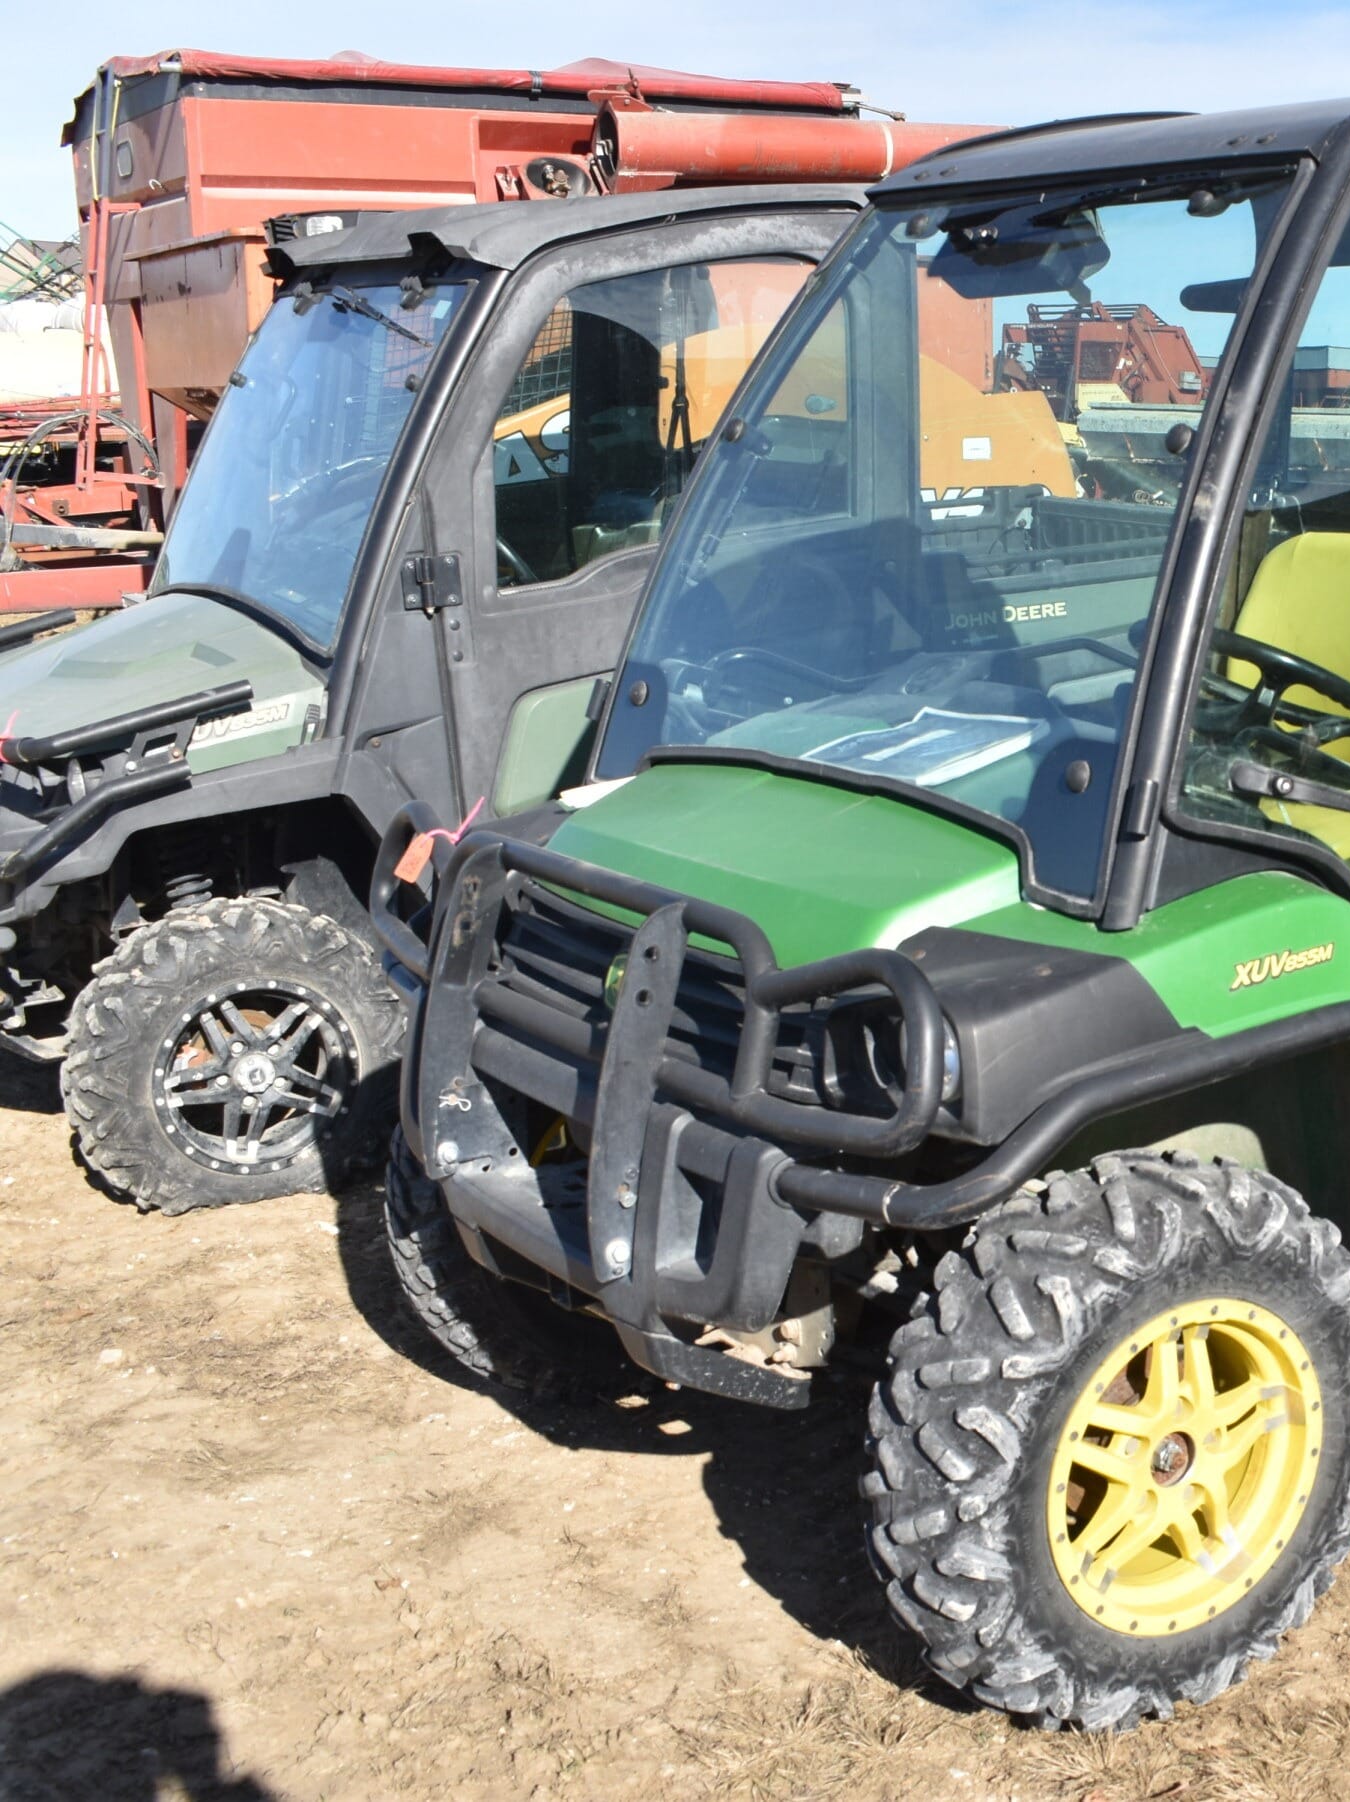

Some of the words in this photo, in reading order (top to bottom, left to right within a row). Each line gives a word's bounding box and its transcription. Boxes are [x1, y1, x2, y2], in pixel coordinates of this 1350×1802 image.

[944, 609, 998, 632] JOHN
[1002, 601, 1067, 623] DEERE
[1230, 942, 1334, 991] XUV855M
